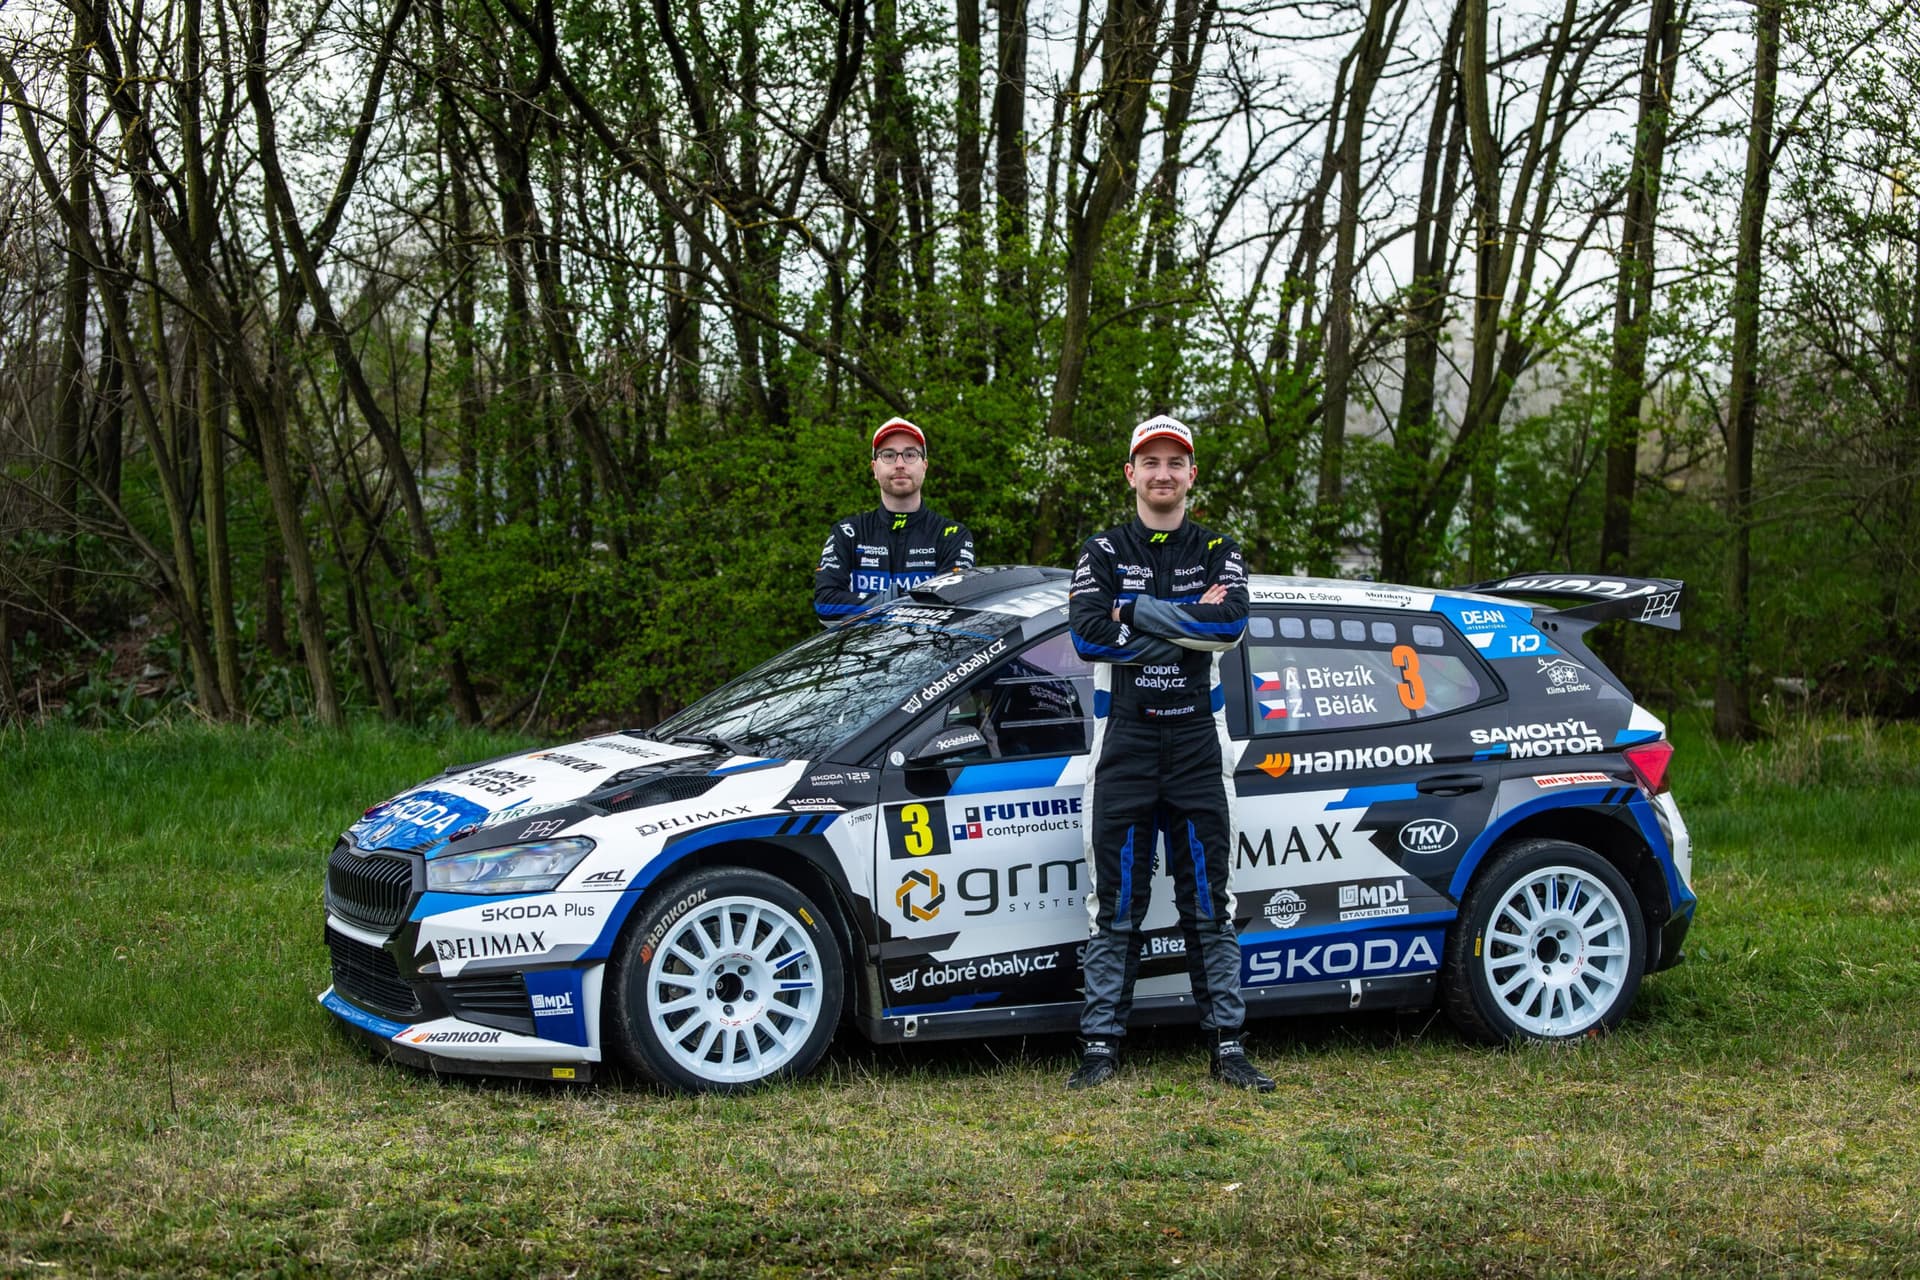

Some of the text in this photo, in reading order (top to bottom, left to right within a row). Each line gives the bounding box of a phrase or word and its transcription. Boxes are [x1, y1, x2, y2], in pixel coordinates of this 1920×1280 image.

[1309, 592, 1342, 603] E-Shop
[1461, 610, 1505, 625] DEAN
[921, 638, 1007, 701] dobré obaly.cz
[1143, 663, 1180, 675] dobré
[1309, 665, 1376, 690] Březík
[1391, 645, 1427, 710] 3
[1135, 675, 1185, 691] obaly.cz
[1292, 694, 1378, 718] Z. Bělák
[1470, 718, 1597, 744] SAMOHÝL
[1510, 736, 1604, 759] MOTOR
[635, 805, 752, 837] DELIMAX
[984, 798, 1082, 821] FUTURE
[900, 803, 934, 856] 3
[986, 819, 1068, 838] contproduct
[1407, 825, 1447, 845] TKV
[565, 902, 596, 917] Plus
[1264, 902, 1307, 916] REMOLD
[1342, 907, 1406, 919] STAVEBNINY
[437, 930, 546, 961] DELIMAX
[921, 962, 977, 987] dobré
[980, 953, 1057, 979] obaly.cz
